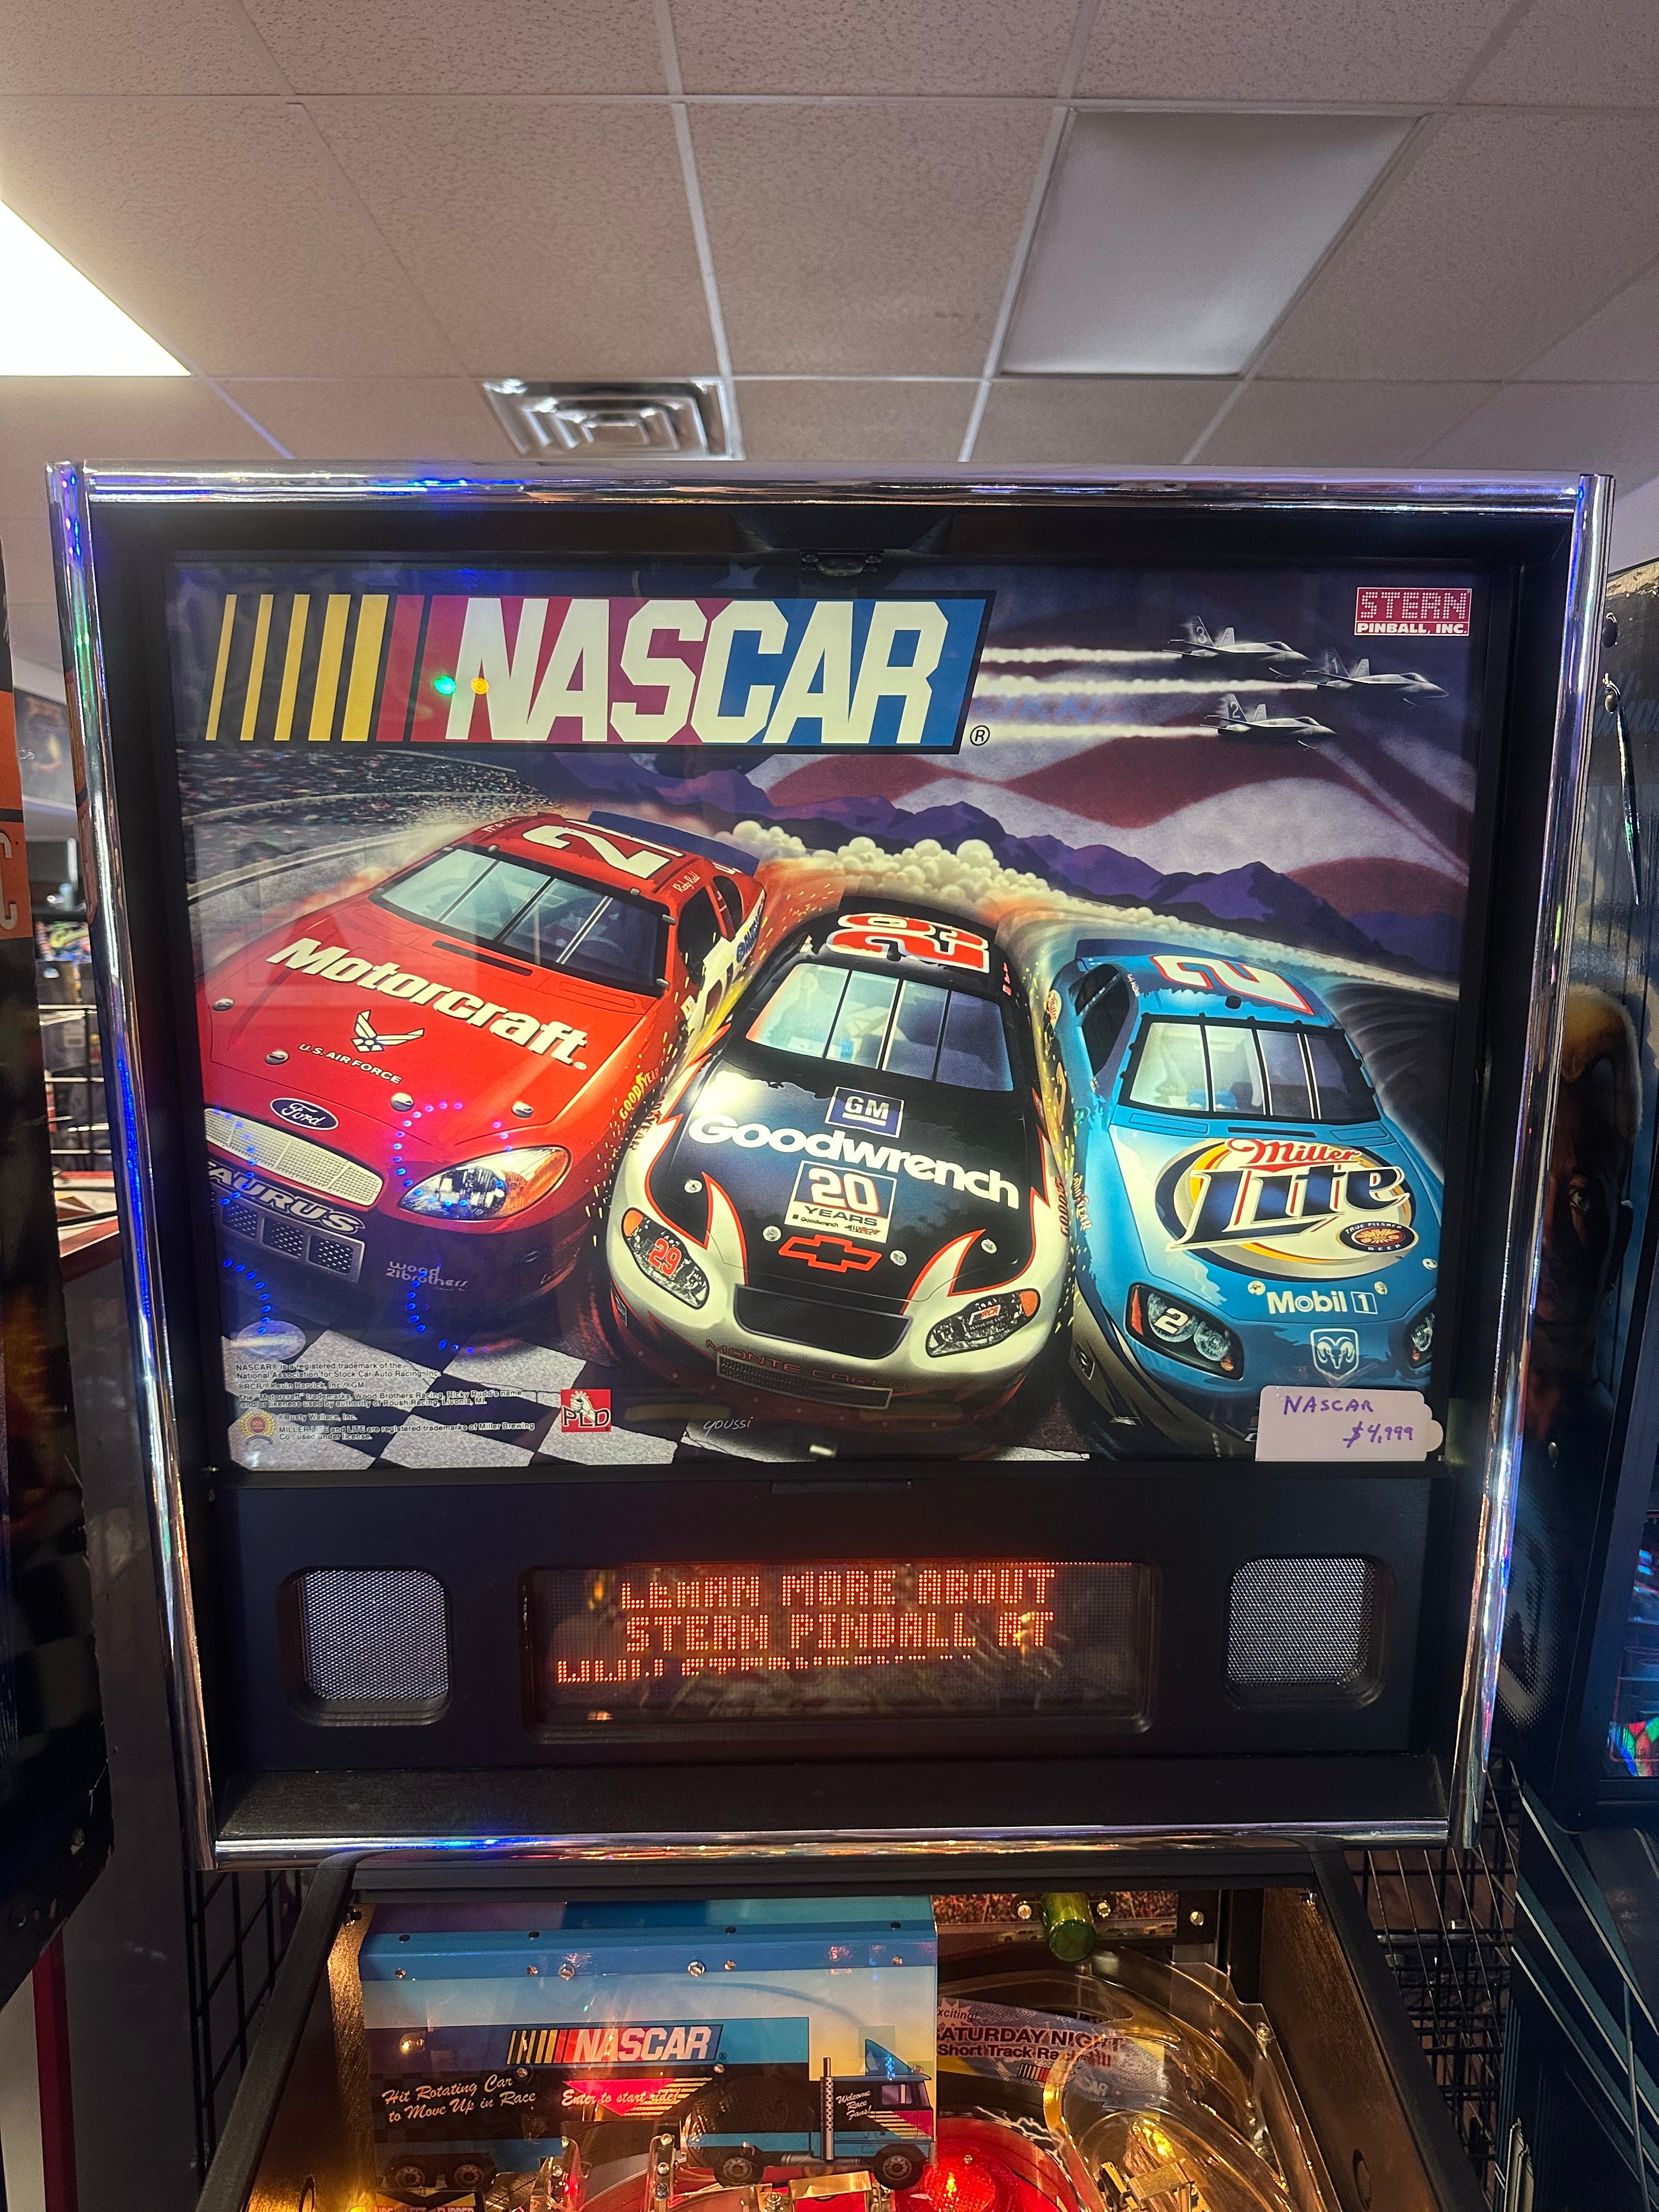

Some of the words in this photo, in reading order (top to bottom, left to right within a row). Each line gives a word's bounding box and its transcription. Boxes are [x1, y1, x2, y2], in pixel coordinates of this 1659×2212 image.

[1361, 590, 1466, 620] STERN
[1195, 625, 1206, 644] 3
[1357, 623, 1431, 635] PINBALL,
[1436, 623, 1468, 634] INC.
[445, 596, 949, 744] NASCAR
[1229, 701, 1240, 719] 2
[1150, 955, 1315, 1016] 2
[266, 937, 588, 1065] Motorcraft
[299, 1043, 324, 1056] U.S.
[325, 1051, 351, 1064] AIR
[351, 1058, 403, 1085] FORCE
[279, 1101, 326, 1127] Ford
[844, 1094, 890, 1121] GM
[688, 1113, 1019, 1210] Goodwrench
[1226, 1138, 1360, 1164] Miller
[808, 1167, 881, 1215] 20
[804, 1205, 878, 1227] YEARS
[1165, 1164, 1410, 1252] Lite
[1345, 1223, 1365, 1234] TRUE
[647, 1237, 682, 1277] 29
[1267, 1291, 1347, 1315] Mobil
[1153, 1308, 1189, 1335] 2
[296, 1363, 336, 1371] registered
[706, 1339, 800, 1374] MONTE
[811, 1369, 908, 1389] CARLO
[324, 1400, 335, 1408] by
[336, 1400, 371, 1408] authority
[447, 1391, 470, 1400] Ricky
[1283, 1395, 1374, 1415] NASCAR
[308, 1413, 342, 1421] Wallace,
[342, 1412, 358, 1421] Inc.
[381, 1425, 421, 1434] registered
[423, 1423, 466, 1432] trademarks
[478, 1422, 501, 1430] Miller
[502, 1422, 535, 1431] Brewing
[561, 1404, 612, 1428] PLD
[342, 1432, 373, 1441] license.
[1342, 1421, 1414, 1449] $4,999
[782, 1570, 896, 1607] MORE
[918, 1568, 1056, 1605] ABOUT
[626, 1613, 769, 1653] STERN
[790, 1612, 977, 1650] PINBALL
[998, 1610, 1054, 1647] AT
[937, 2008, 978, 2023] xciting!
[573, 2026, 712, 2062] NASCAR
[937, 2044, 987, 2057] Short
[988, 2044, 1036, 2058] Track
[382, 2089, 411, 2105] Hit
[415, 2083, 478, 2101] Rotating
[483, 2074, 514, 2093] Car
[561, 2088, 597, 2107] Enter
[600, 2091, 612, 2104] to
[616, 2090, 646, 2103] start
[649, 2087, 682, 2103] ride!
[836, 2090, 871, 2104] Welcome
[388, 2111, 402, 2123] to
[404, 2104, 447, 2120] Move
[449, 2098, 476, 2115] Up
[480, 2097, 494, 2109] in
[499, 2091, 537, 2106] Race
[846, 2100, 868, 2111] Race
[846, 2104, 872, 2121] Fans!
